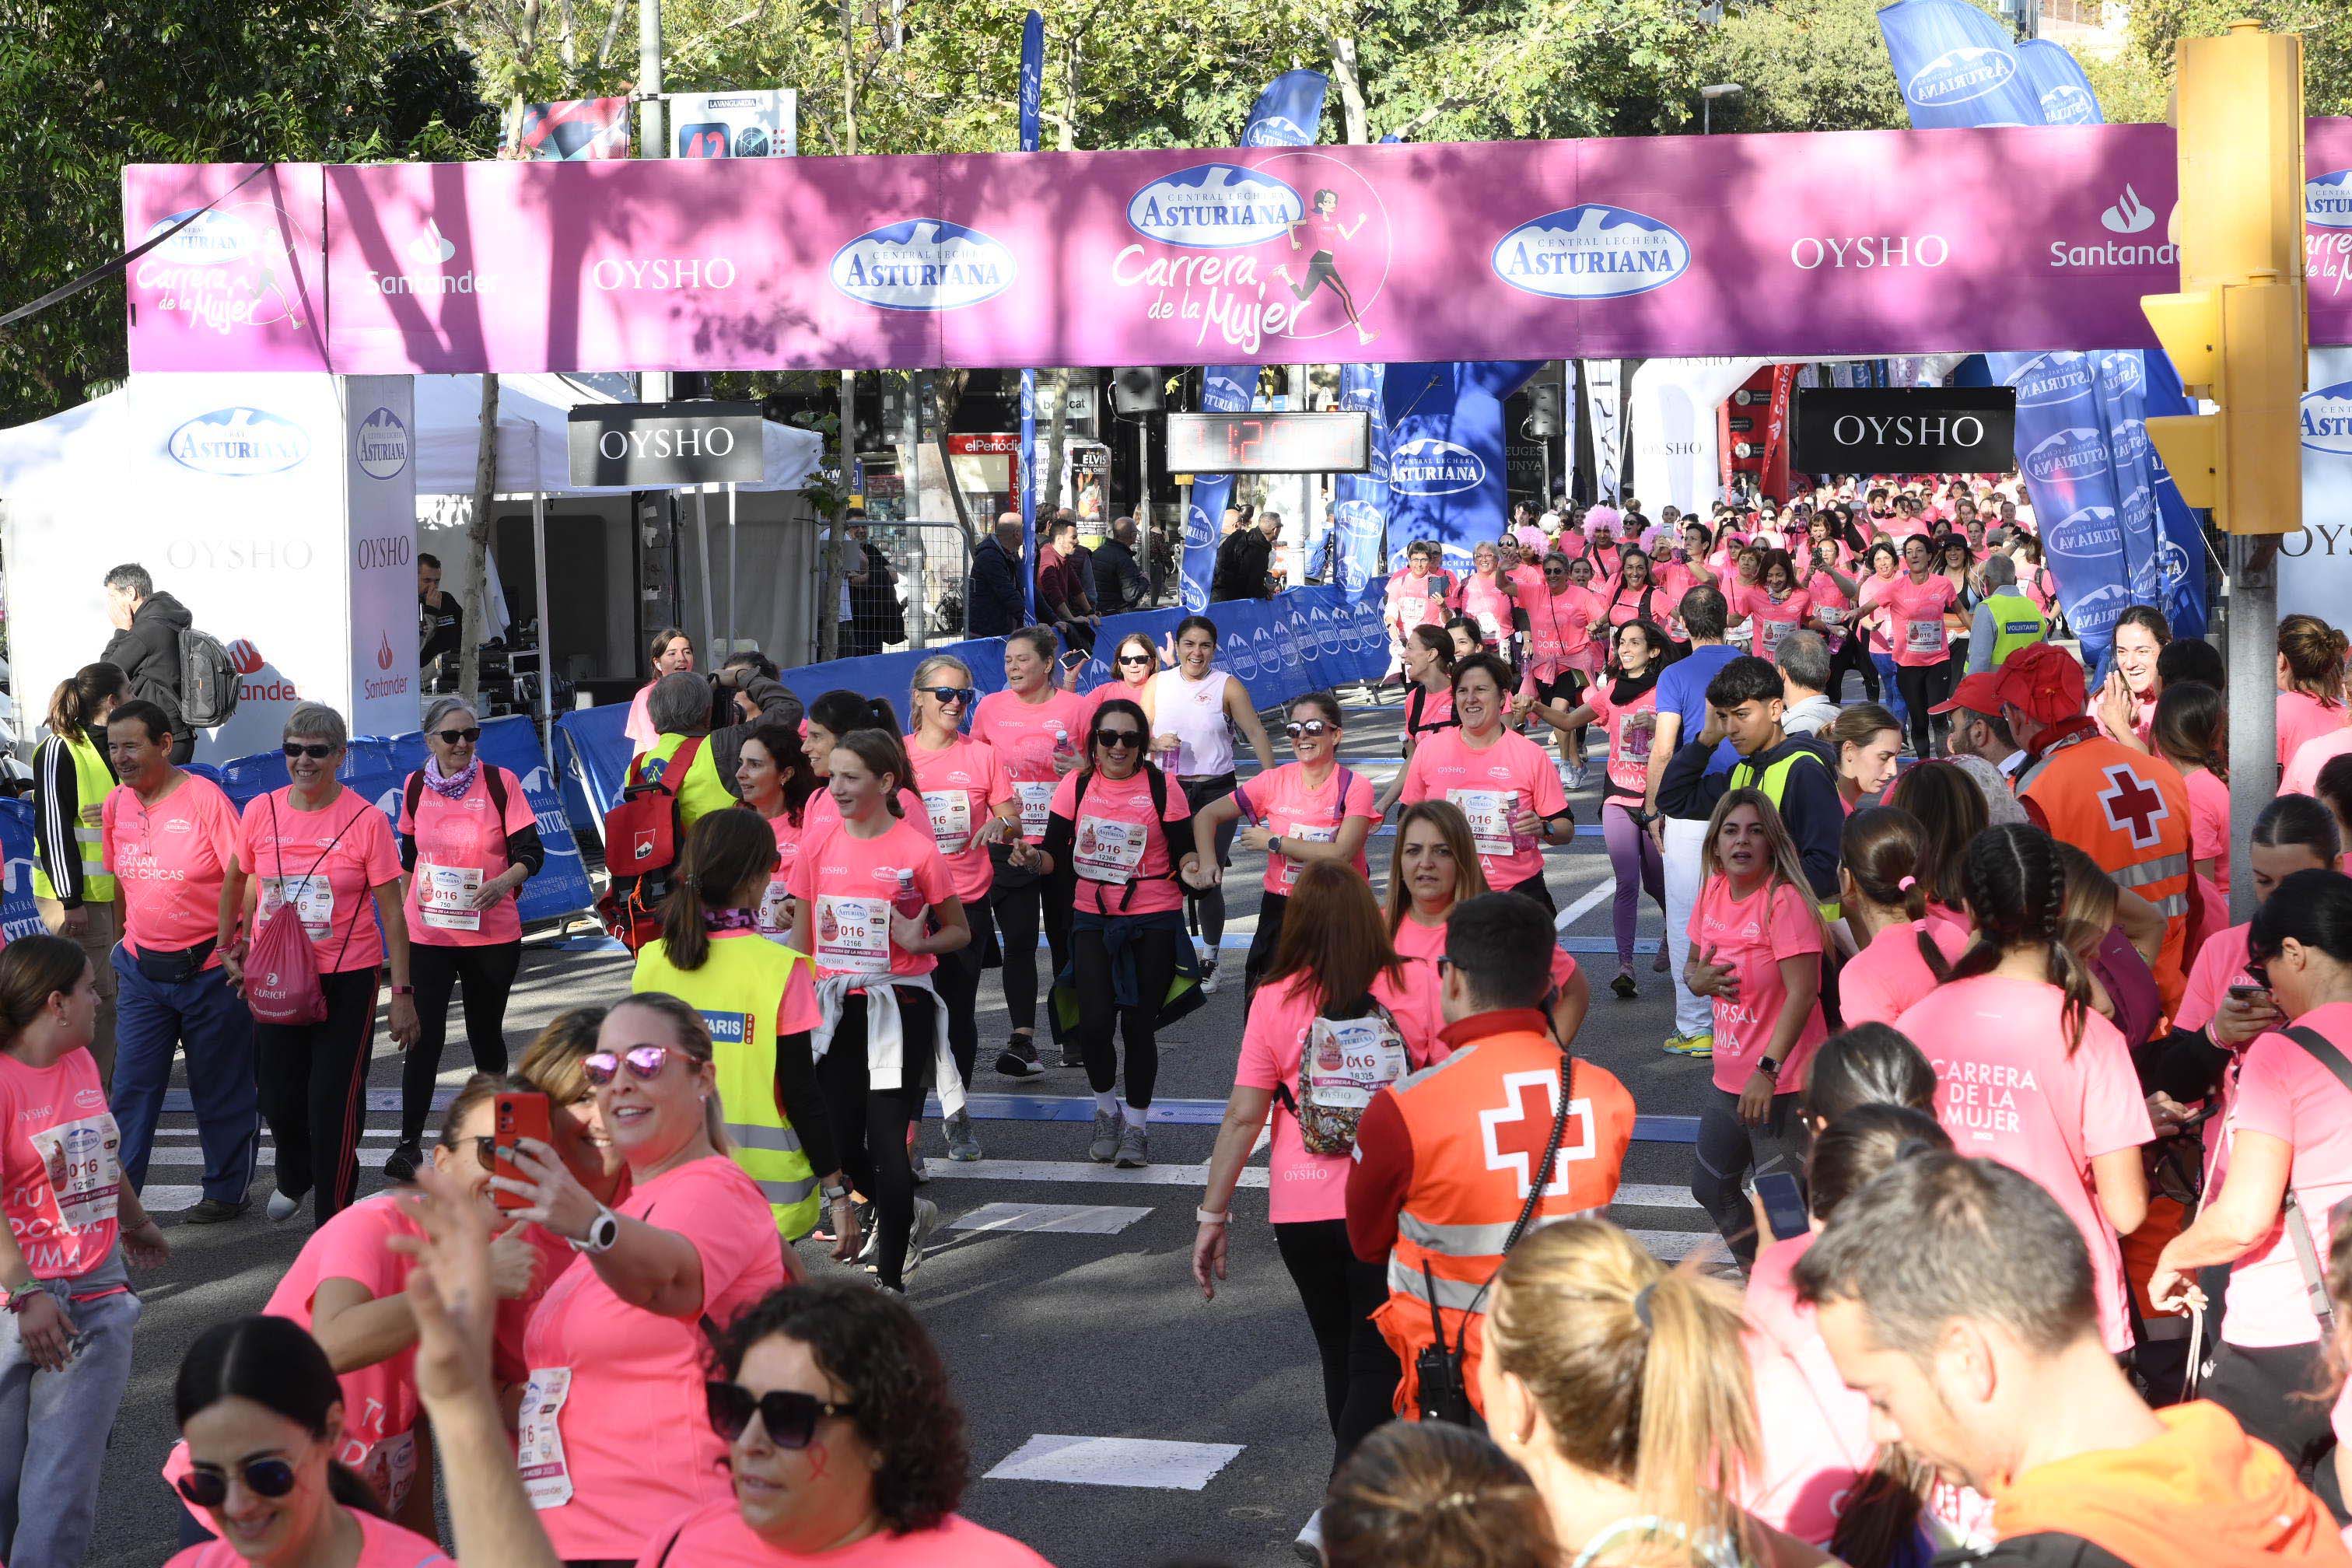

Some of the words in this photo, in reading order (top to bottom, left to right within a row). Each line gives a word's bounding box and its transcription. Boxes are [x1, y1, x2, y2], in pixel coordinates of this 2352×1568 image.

[1168, 192, 1223, 201] CENTRAL
[1141, 195, 1290, 227] ASTURIANA
[1538, 237, 1598, 247] CENTRAL
[1606, 236, 1668, 247] LECHERA
[873, 250, 932, 260] CENTRAL
[1507, 240, 1675, 275] ASTURIANA
[1790, 234, 1949, 270] OYSHO
[593, 258, 737, 292] OYSHO
[845, 253, 1002, 288] ASTURIANA
[1111, 243, 1258, 287] Carrera
[365, 269, 498, 296] Santander
[159, 292, 176, 310] de
[1148, 290, 1174, 320] de
[1181, 291, 1200, 320] la
[1196, 282, 1312, 355] Mujer
[1204, 393, 1245, 411] STURIANA
[1832, 415, 1984, 447] OYSHO
[179, 432, 301, 460] ASTURIANA
[359, 437, 406, 462] ASTURIANA
[599, 427, 735, 460] OYSHO
[1082, 454, 1108, 464] ELVIS
[1390, 461, 1479, 483] ASTURIANA
[166, 538, 313, 571] OYSHO
[358, 535, 410, 570] OYSHO
[1537, 630, 1547, 639] TU
[1538, 639, 1569, 649] DORSAL
[364, 675, 409, 701] Santander
[1025, 803, 1046, 811] 016
[931, 815, 947, 825] 16
[1468, 814, 1492, 824] 016
[1097, 843, 1121, 854] 016
[117, 855, 157, 868] GANAN
[117, 868, 135, 880] LAS
[138, 869, 185, 881] CHICAS
[435, 890, 458, 901] 016
[840, 926, 865, 937] 016
[1346, 1055, 1376, 1069] 016
[1349, 1071, 1374, 1081] 18325
[1930, 1059, 2037, 1092] CARRERA
[1321, 1090, 1352, 1100] OYSHO
[1949, 1082, 1979, 1106] DE
[1987, 1087, 2017, 1110] LA
[1944, 1104, 2021, 1133] MUJER
[68, 1158, 99, 1178] 016
[1284, 1168, 1328, 1183] OYSHO
[72, 1178, 96, 1191] 12167
[13, 1185, 44, 1208] TU
[26, 1244, 81, 1269] UMA
